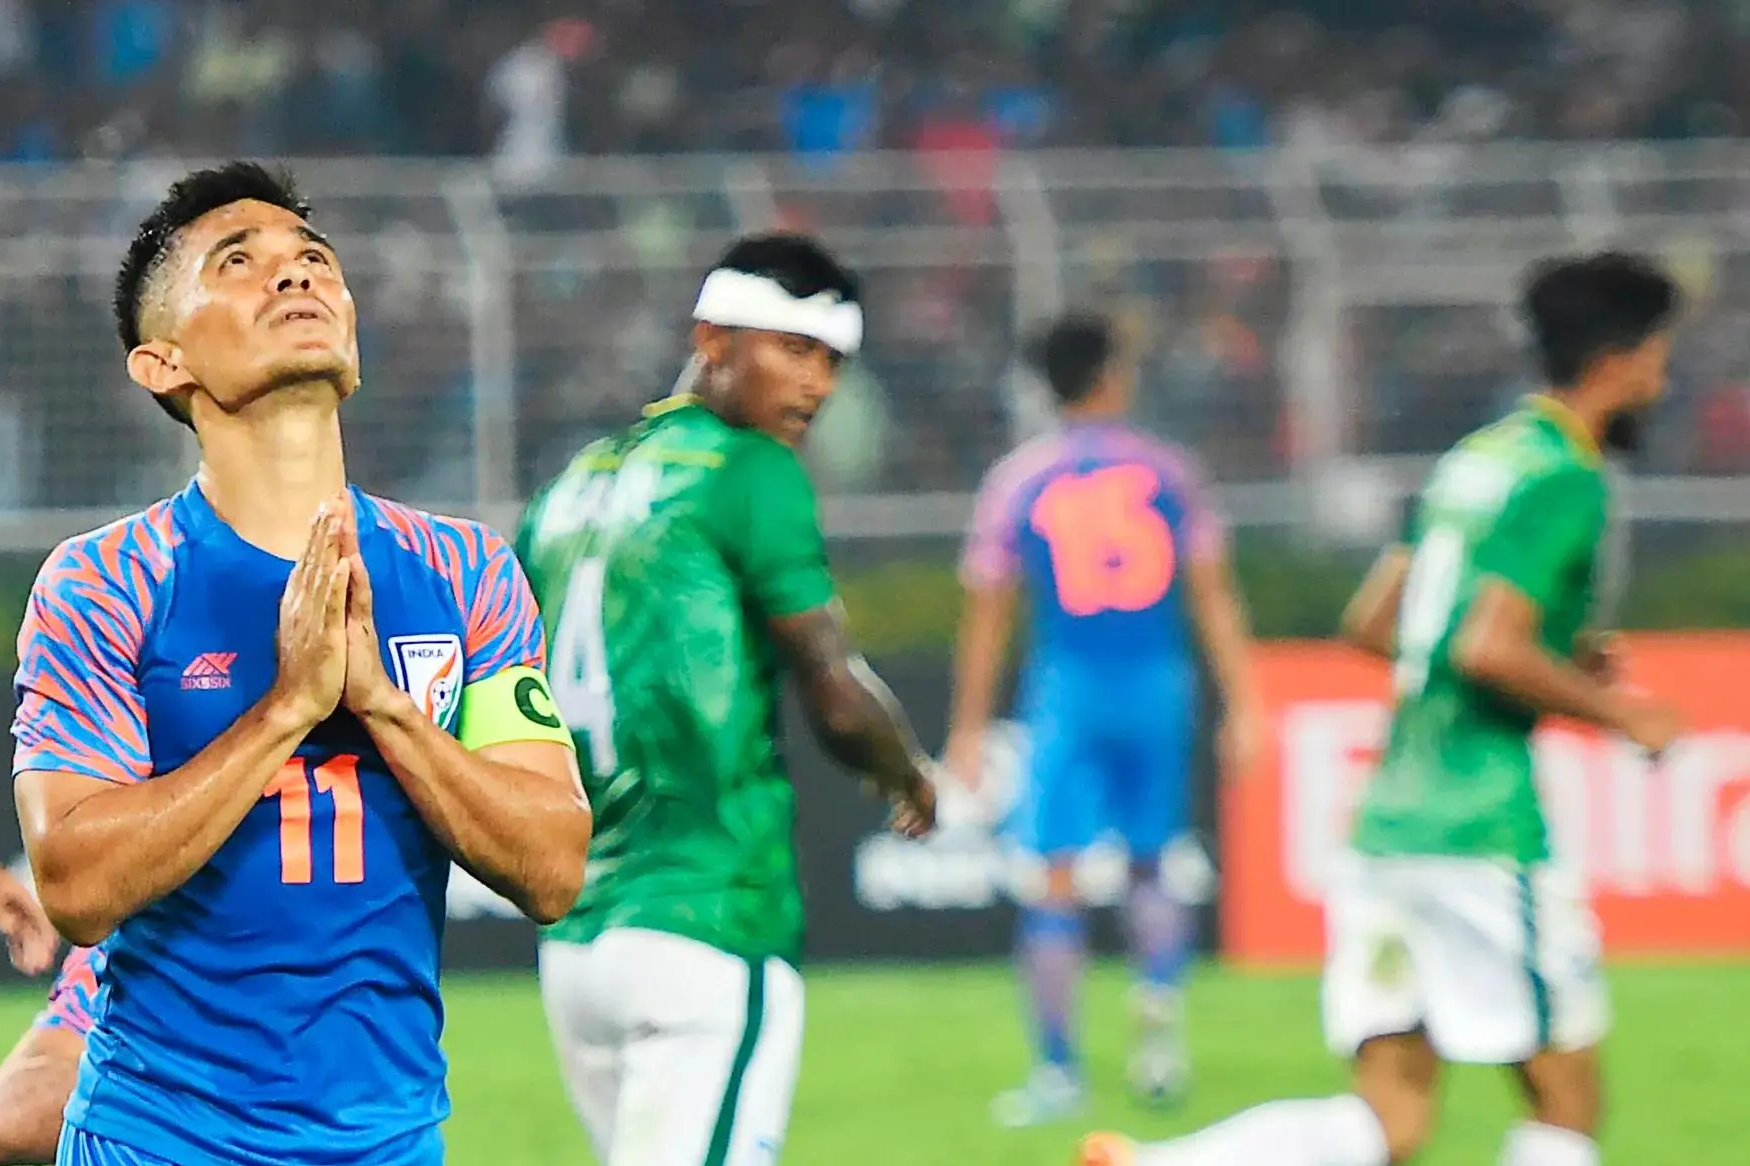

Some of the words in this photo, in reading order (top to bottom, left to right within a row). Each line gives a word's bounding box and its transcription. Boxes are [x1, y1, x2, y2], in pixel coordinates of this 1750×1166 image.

[407, 648, 445, 659] INDIA
[550, 556, 618, 777] 4
[514, 676, 562, 729] C
[262, 753, 365, 884] 11
